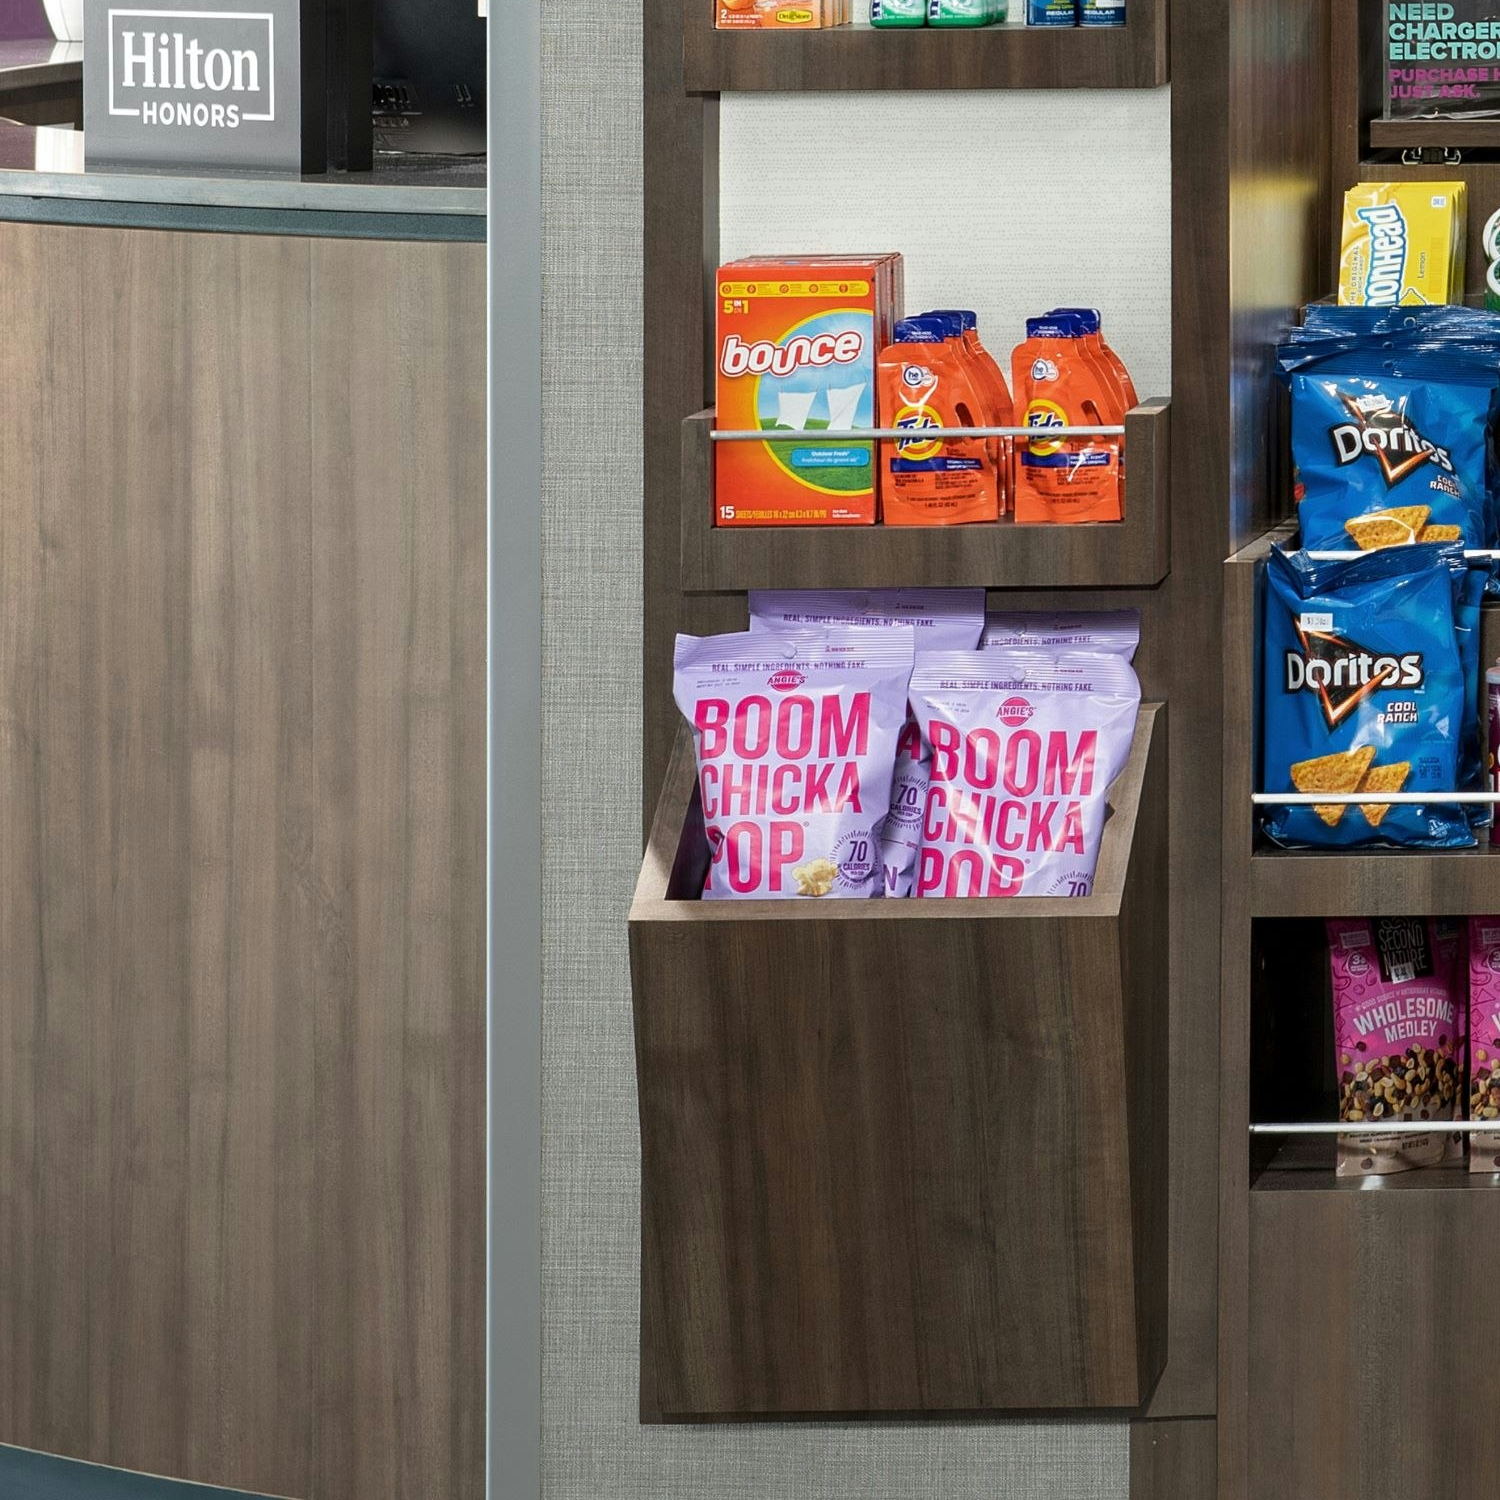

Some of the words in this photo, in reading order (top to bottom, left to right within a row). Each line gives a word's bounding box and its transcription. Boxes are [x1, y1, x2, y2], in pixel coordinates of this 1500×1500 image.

[1389, 2, 1454, 22] NEED
[122, 30, 261, 93] Hilton
[1388, 67, 1490, 83] PURCHASE
[1389, 85, 1435, 99] JUST
[142, 100, 241, 128] HONORS
[720, 330, 864, 377] bounce
[1332, 423, 1454, 472] Doritos
[720, 505, 735, 519] 15
[734, 662, 761, 672] SIMPLE
[814, 660, 845, 670] NOTHING
[1287, 653, 1424, 690] Doritos
[1377, 712, 1419, 724] RANCH
[1386, 701, 1418, 712] COOL
[693, 691, 872, 761] BOOM
[927, 719, 1098, 798] BOOM
[700, 760, 864, 819] CHICKA
[924, 786, 1086, 856] CHICKA
[703, 820, 805, 894] POP
[848, 840, 868, 863] 70
[919, 847, 1024, 897] POP
